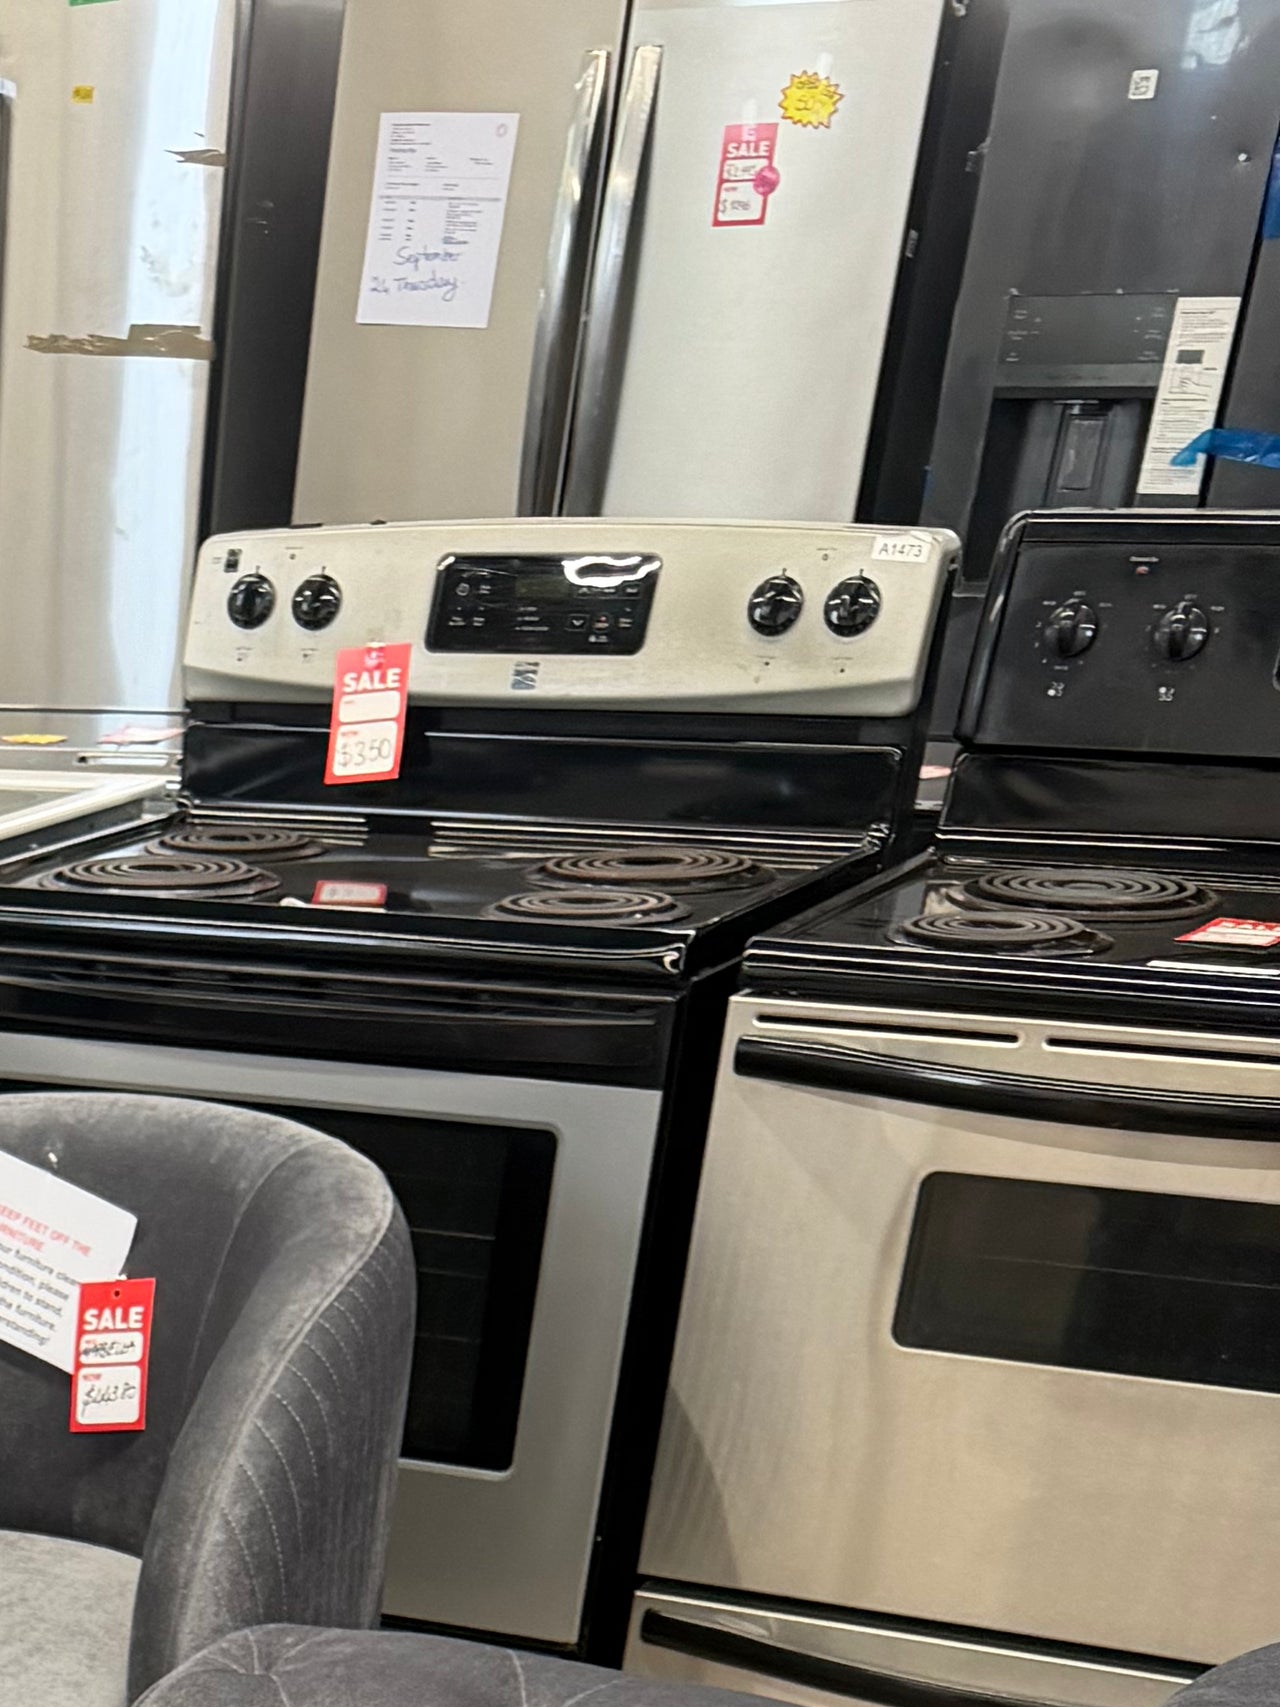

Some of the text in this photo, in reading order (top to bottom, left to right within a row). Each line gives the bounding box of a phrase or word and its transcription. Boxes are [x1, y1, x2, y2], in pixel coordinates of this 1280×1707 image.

[726, 141, 771, 157] SALE
[879, 543, 922, 557] A1473
[343, 667, 401, 693] SALE
[336, 738, 391, 768] $350
[83, 1305, 144, 1331] SALE
